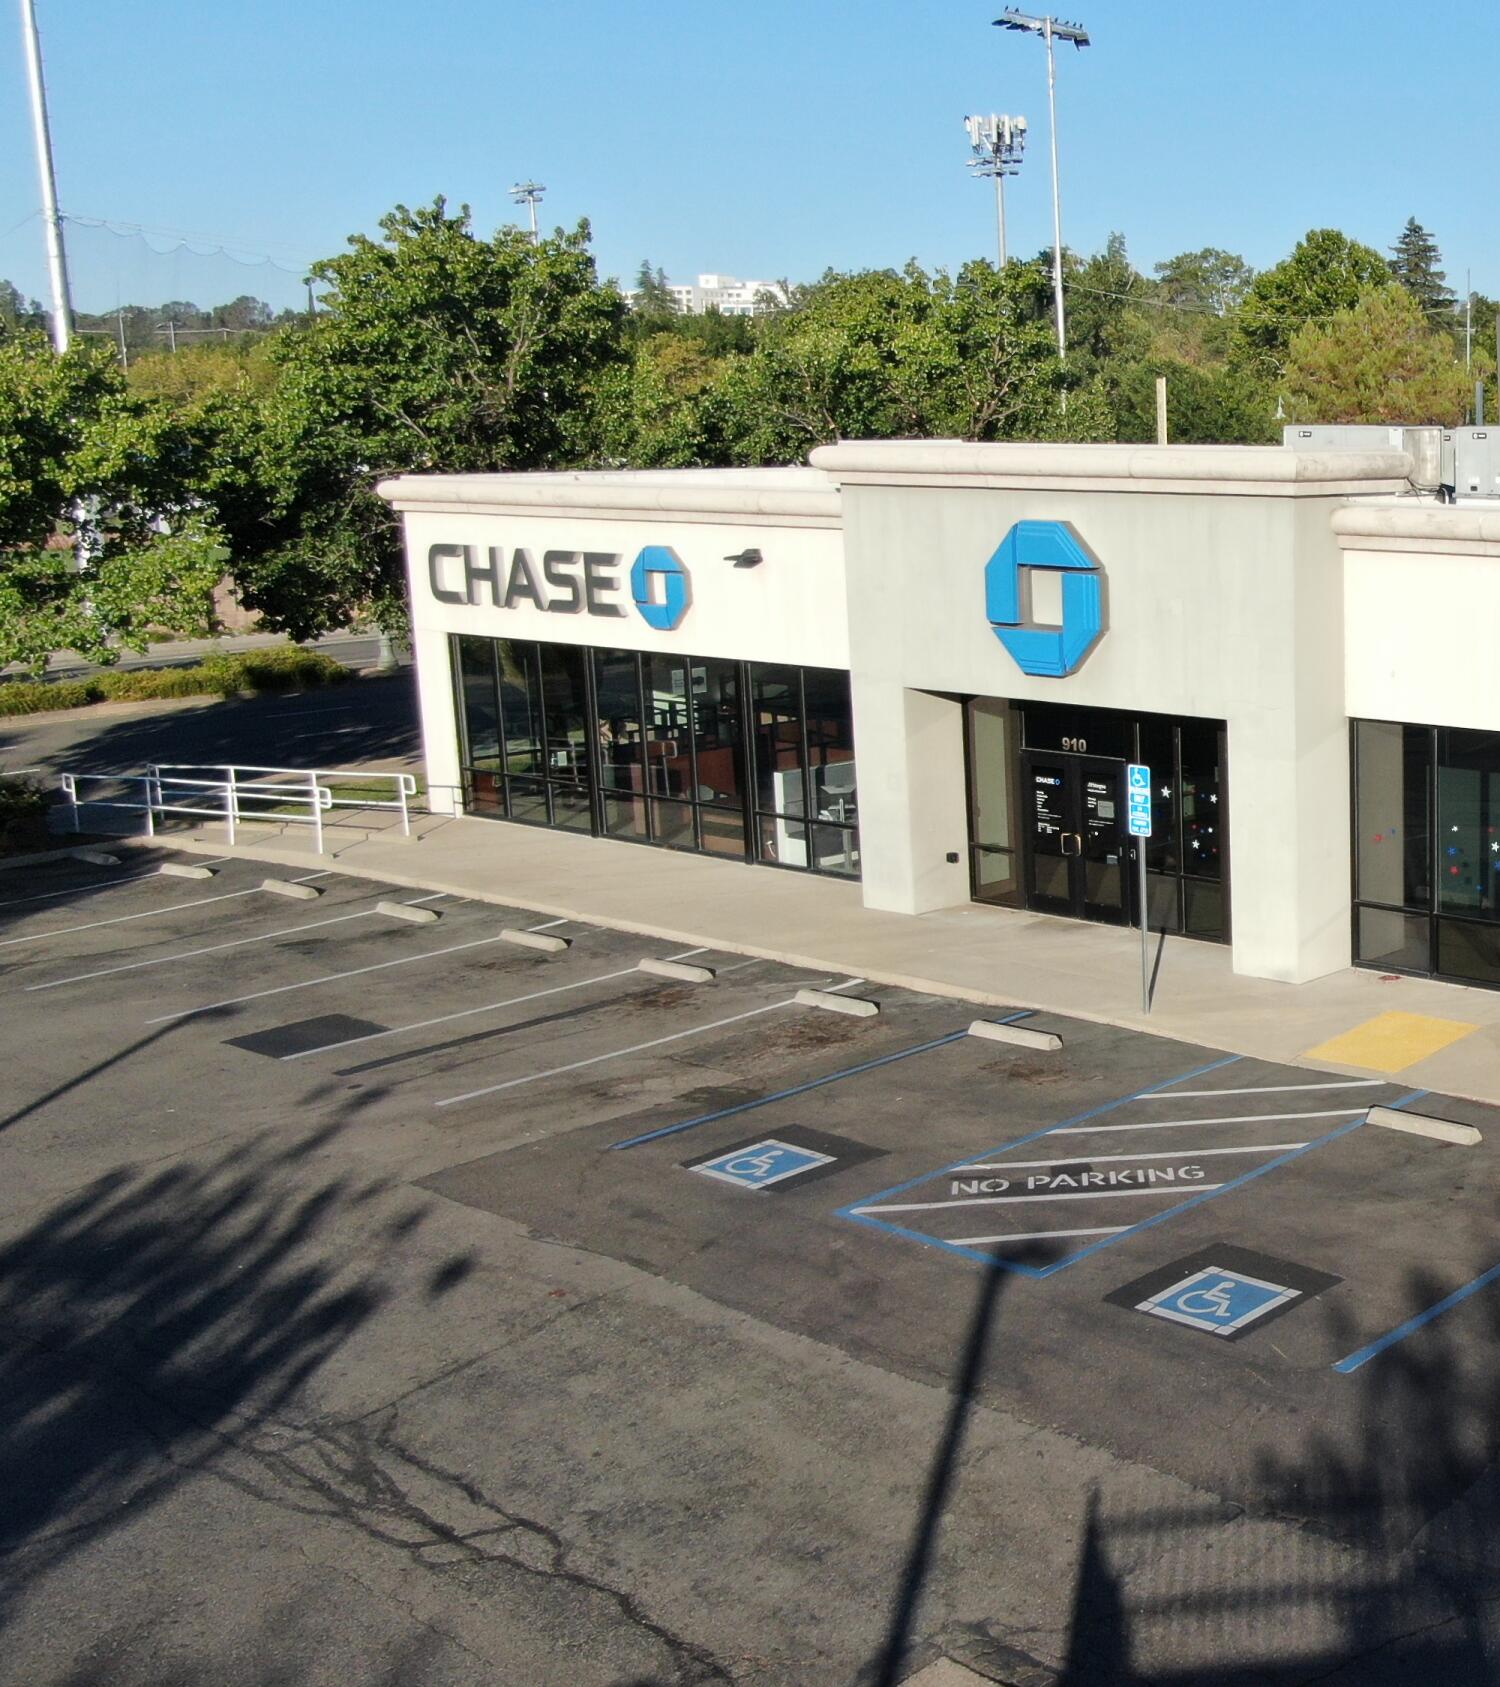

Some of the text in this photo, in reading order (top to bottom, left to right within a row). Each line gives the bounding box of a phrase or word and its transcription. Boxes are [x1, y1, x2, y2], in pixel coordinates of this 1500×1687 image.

[429, 543, 628, 617] CHASE
[1062, 737, 1087, 752] 910
[1035, 776, 1055, 785] CHASE
[951, 1165, 1206, 1196] NO PARKING
